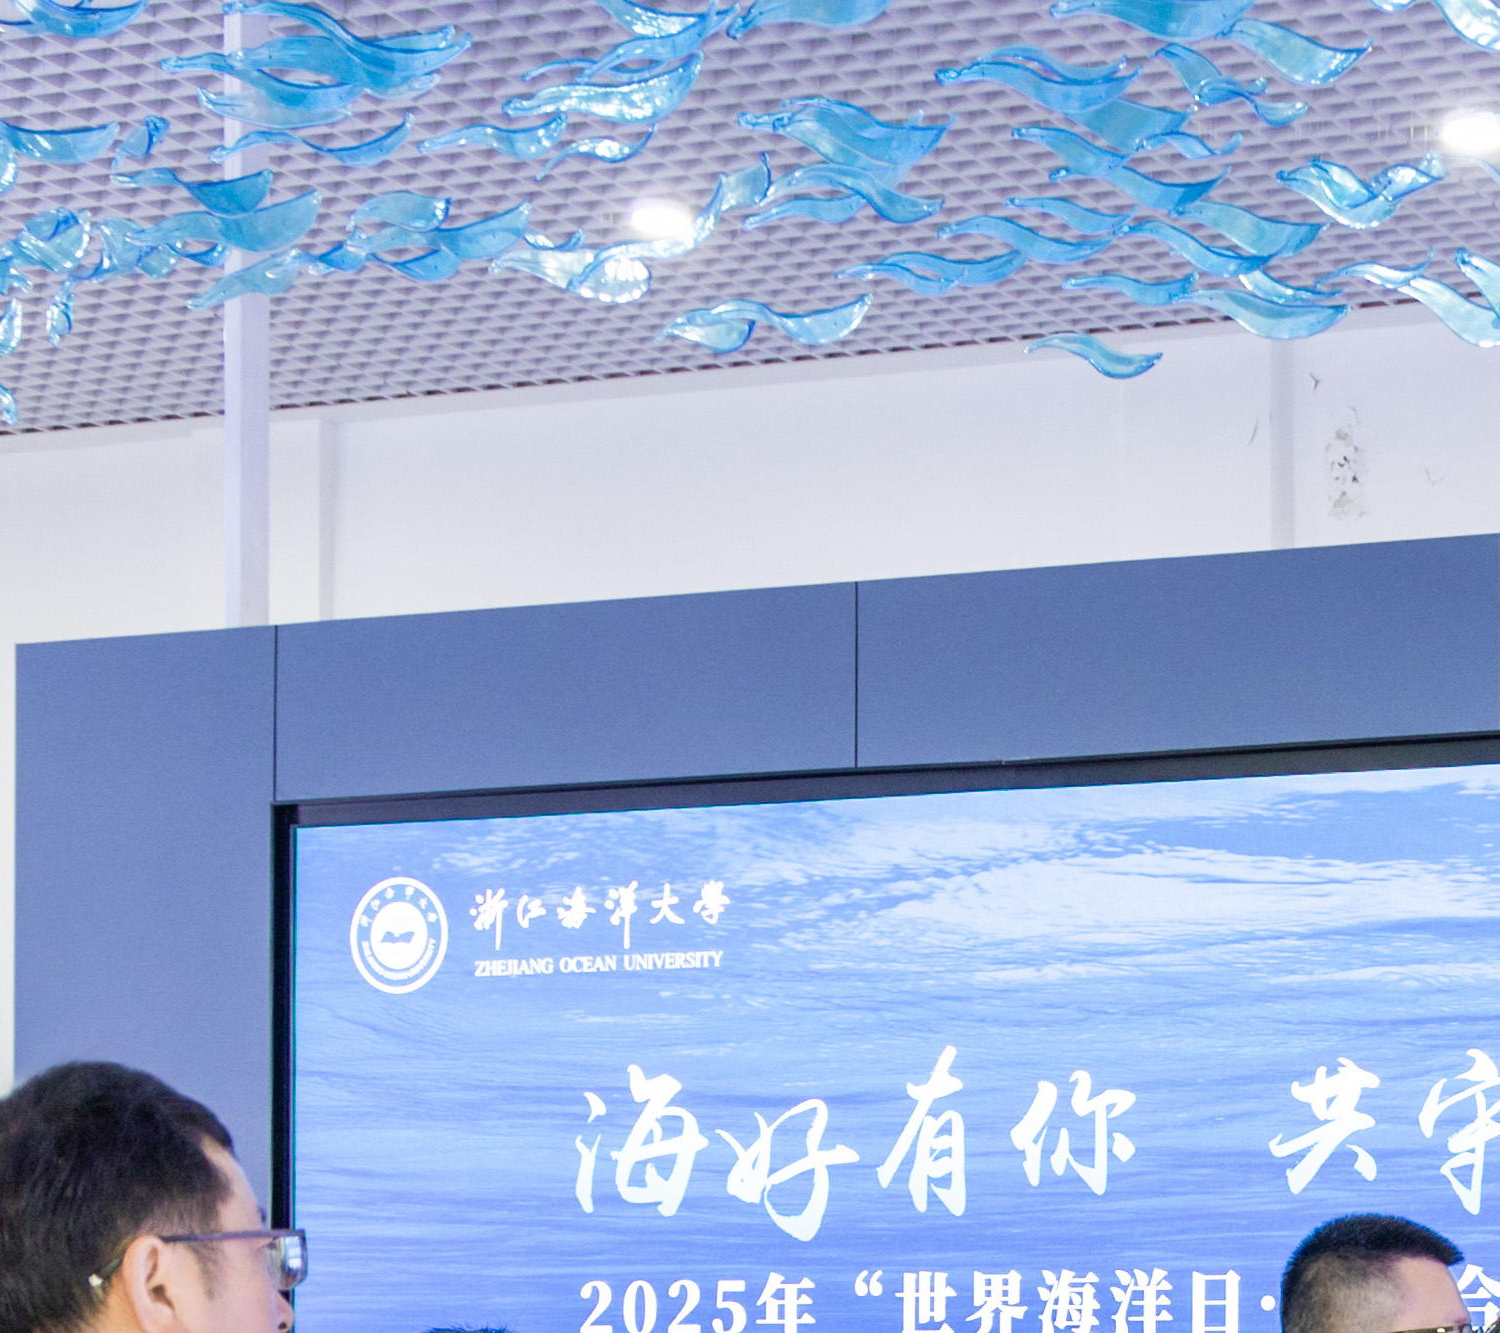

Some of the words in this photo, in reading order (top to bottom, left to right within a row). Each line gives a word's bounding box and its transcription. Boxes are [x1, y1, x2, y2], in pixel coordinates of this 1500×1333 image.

[474, 957, 554, 977] ZHEJIANG
[559, 954, 617, 974] OCEAN
[623, 950, 724, 971] UNIVERSITY
[575, 1044, 1137, 1242] 海好有你
